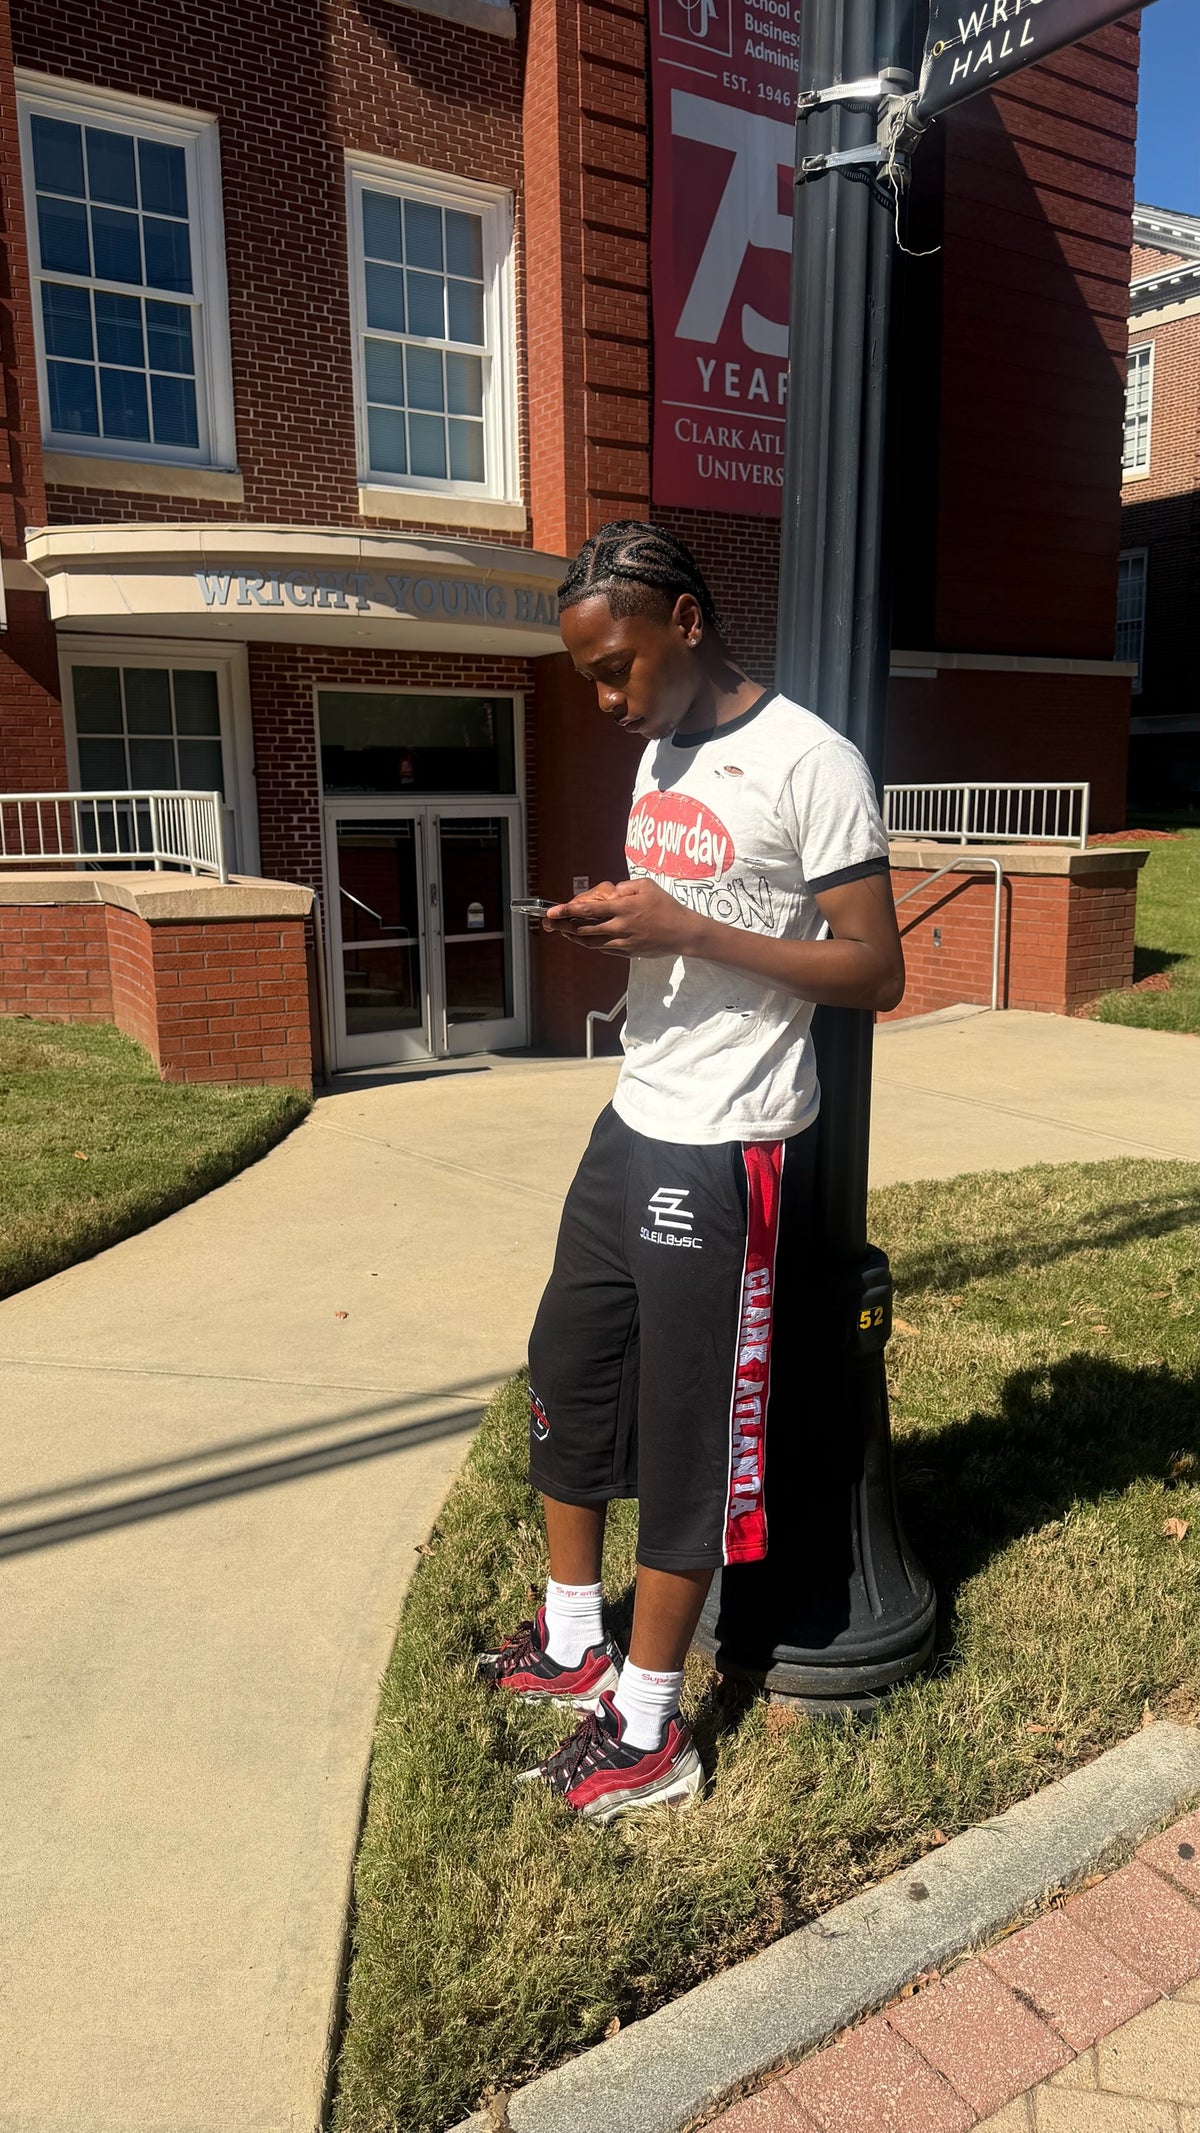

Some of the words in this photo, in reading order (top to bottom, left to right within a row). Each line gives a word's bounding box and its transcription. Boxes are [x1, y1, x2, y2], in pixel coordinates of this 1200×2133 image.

[744, 38, 799, 72] Adminis
[950, 18, 1034, 85] HALL
[723, 71, 751, 94] EST.
[757, 83, 791, 107] 1946
[674, 418, 744, 449] CLARK
[749, 429, 785, 455] ATL
[697, 454, 784, 487] UNIVERS
[193, 569, 506, 619] WRIGHT-YOUNG
[514, 588, 560, 626] HAL
[656, 820, 687, 868] your
[685, 812, 727, 882] day
[741, 1267, 772, 1366] CLARK
[859, 1306, 884, 1330] 52
[730, 1378, 765, 1520] ATLANTA
